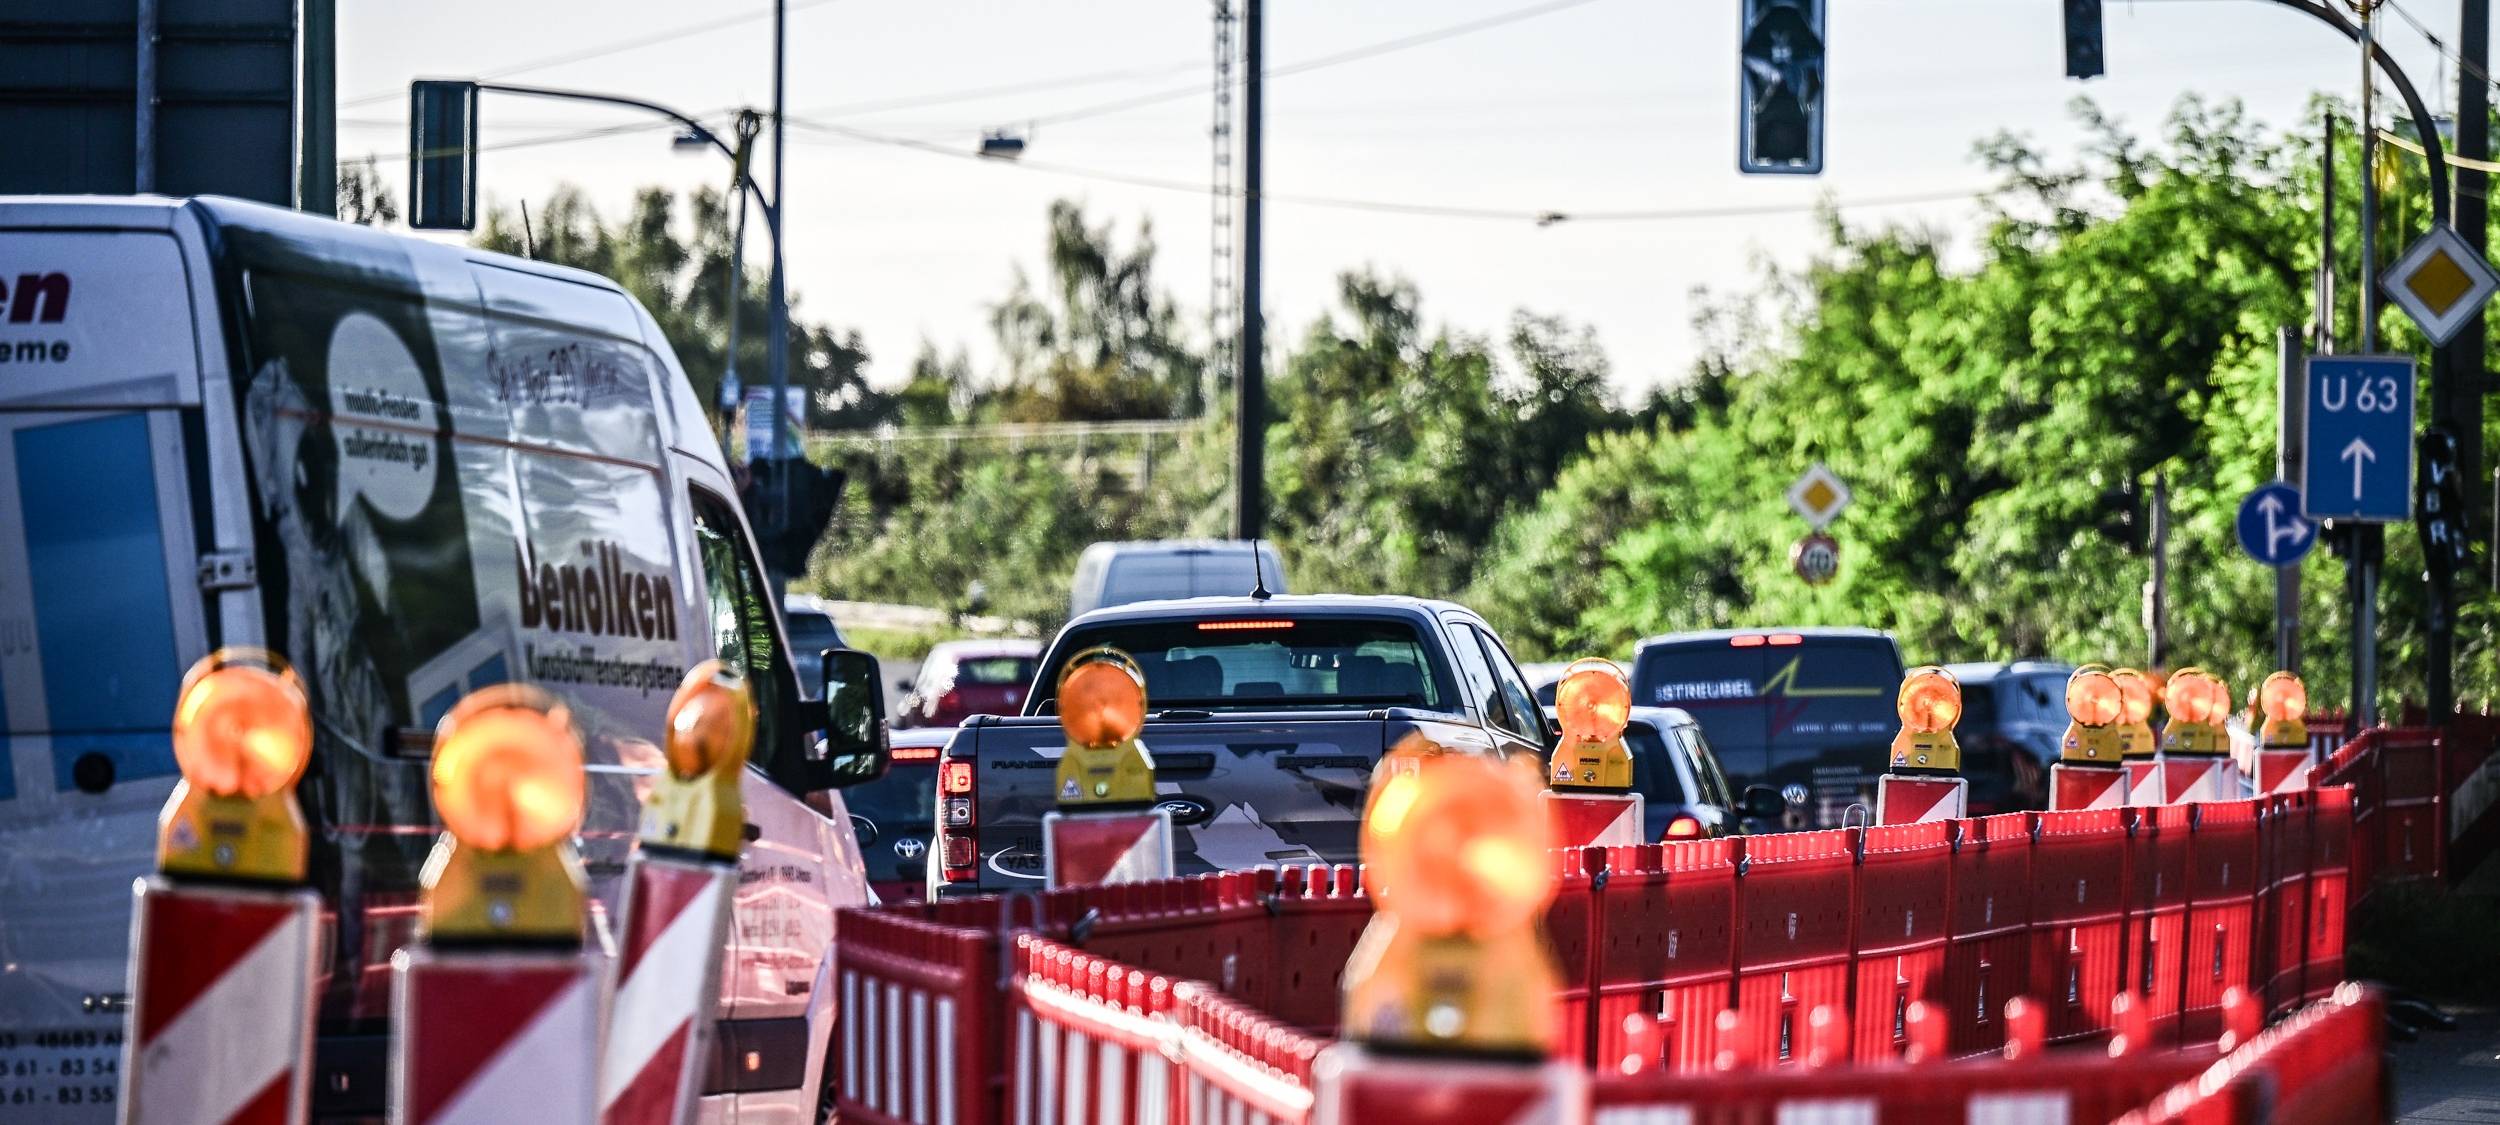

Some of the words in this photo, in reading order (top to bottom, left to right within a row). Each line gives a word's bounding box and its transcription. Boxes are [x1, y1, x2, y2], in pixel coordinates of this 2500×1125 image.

[2322, 375, 2347, 412] U
[2356, 376, 2398, 412] 63
[514, 538, 679, 642] Benölken
[1662, 679, 1754, 701] STREUBEL
[991, 760, 1058, 770] RANGE
[1166, 804, 1192, 815] Ford
[1016, 836, 1043, 851] Flie
[1006, 856, 1043, 869] YAS
[14, 1058, 37, 1077] 61
[61, 1058, 85, 1077] 83
[92, 1057, 117, 1077] 54
[12, 1086, 35, 1105] 61
[58, 1085, 83, 1105] 83
